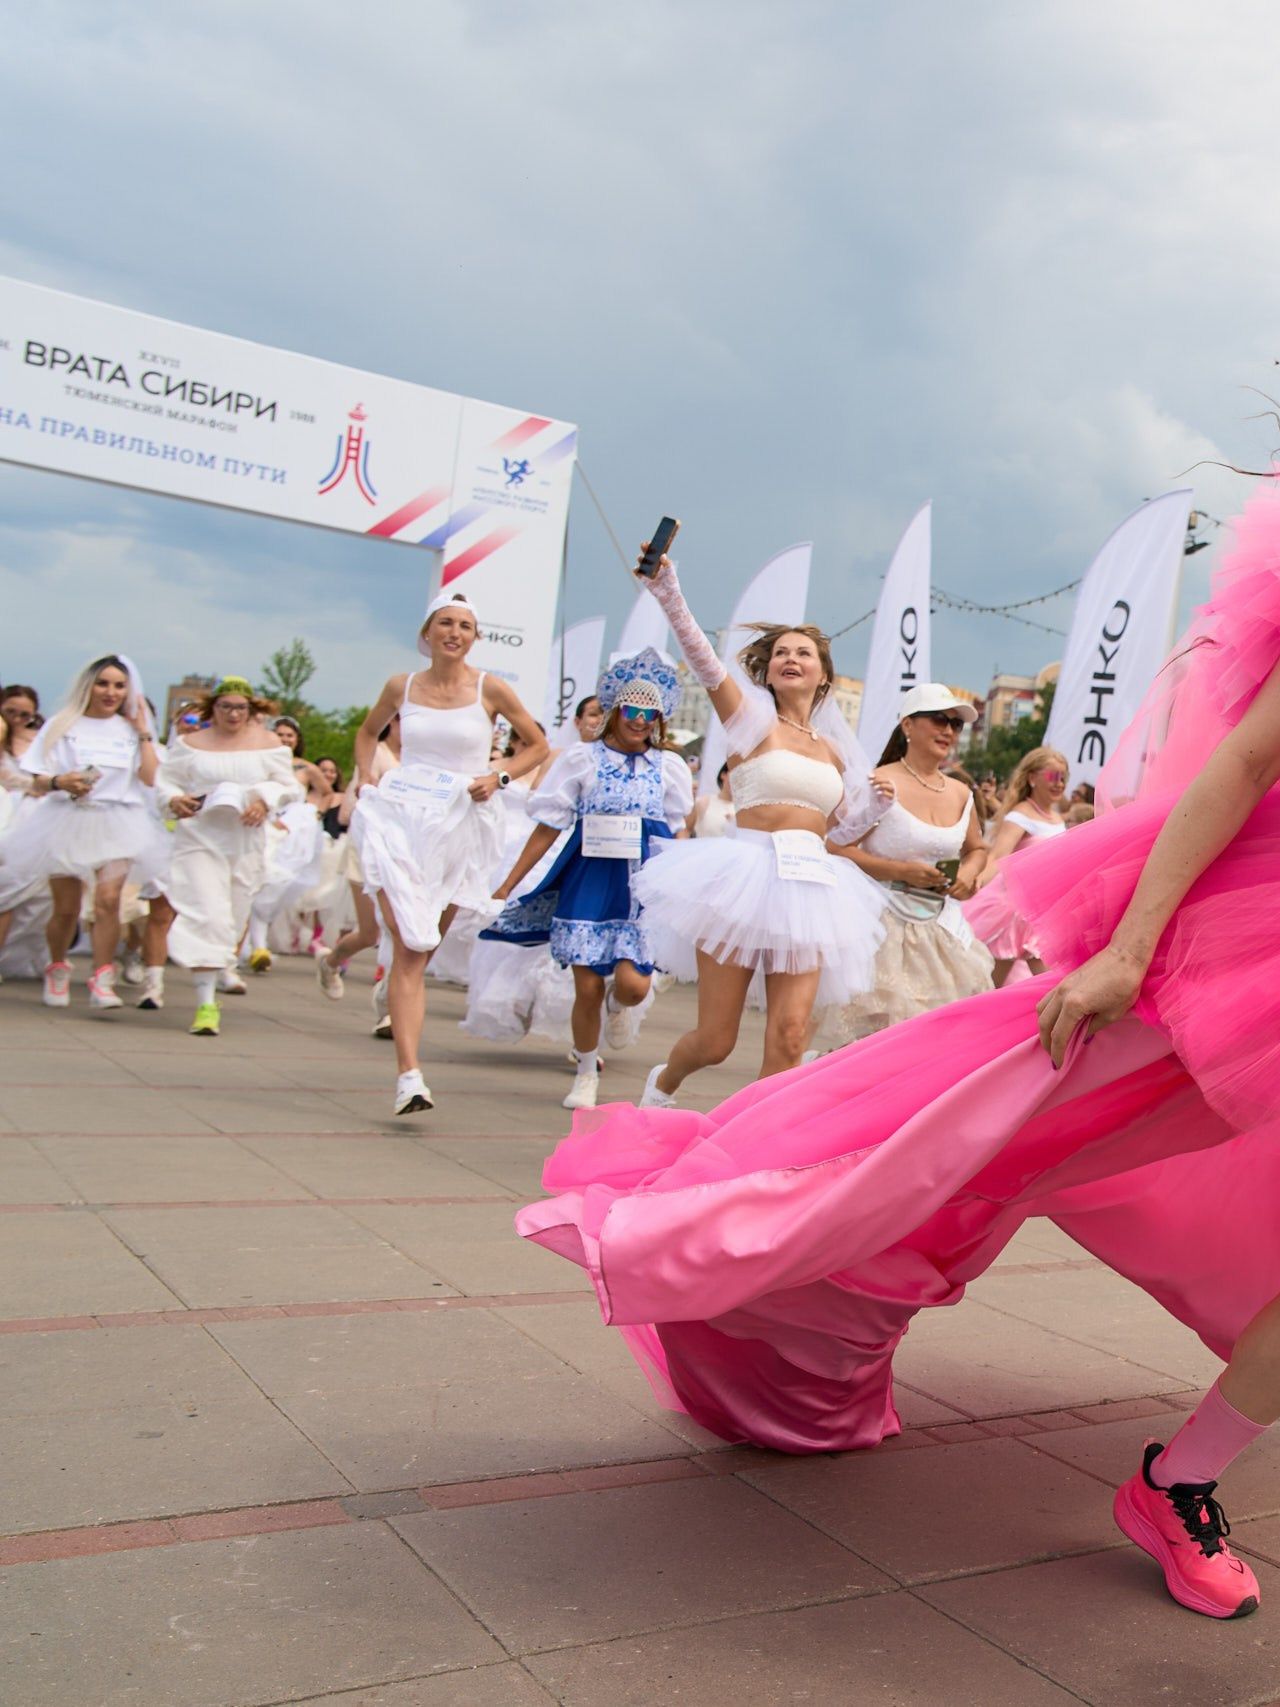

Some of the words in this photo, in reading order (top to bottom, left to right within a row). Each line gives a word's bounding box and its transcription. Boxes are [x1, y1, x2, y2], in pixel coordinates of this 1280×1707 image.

[25, 340, 131, 388] ВРАТА
[141, 371, 277, 422] СИБИРИ
[64, 384, 163, 415] ТЮМЕНСКИЙ
[166, 410, 238, 433] МАРАФОН
[0, 406, 31, 429] НА
[40, 416, 217, 469] ПРАВИЛЬНОМ
[223, 457, 287, 484] ПУТИ
[1078, 600, 1130, 767] ЭНКО
